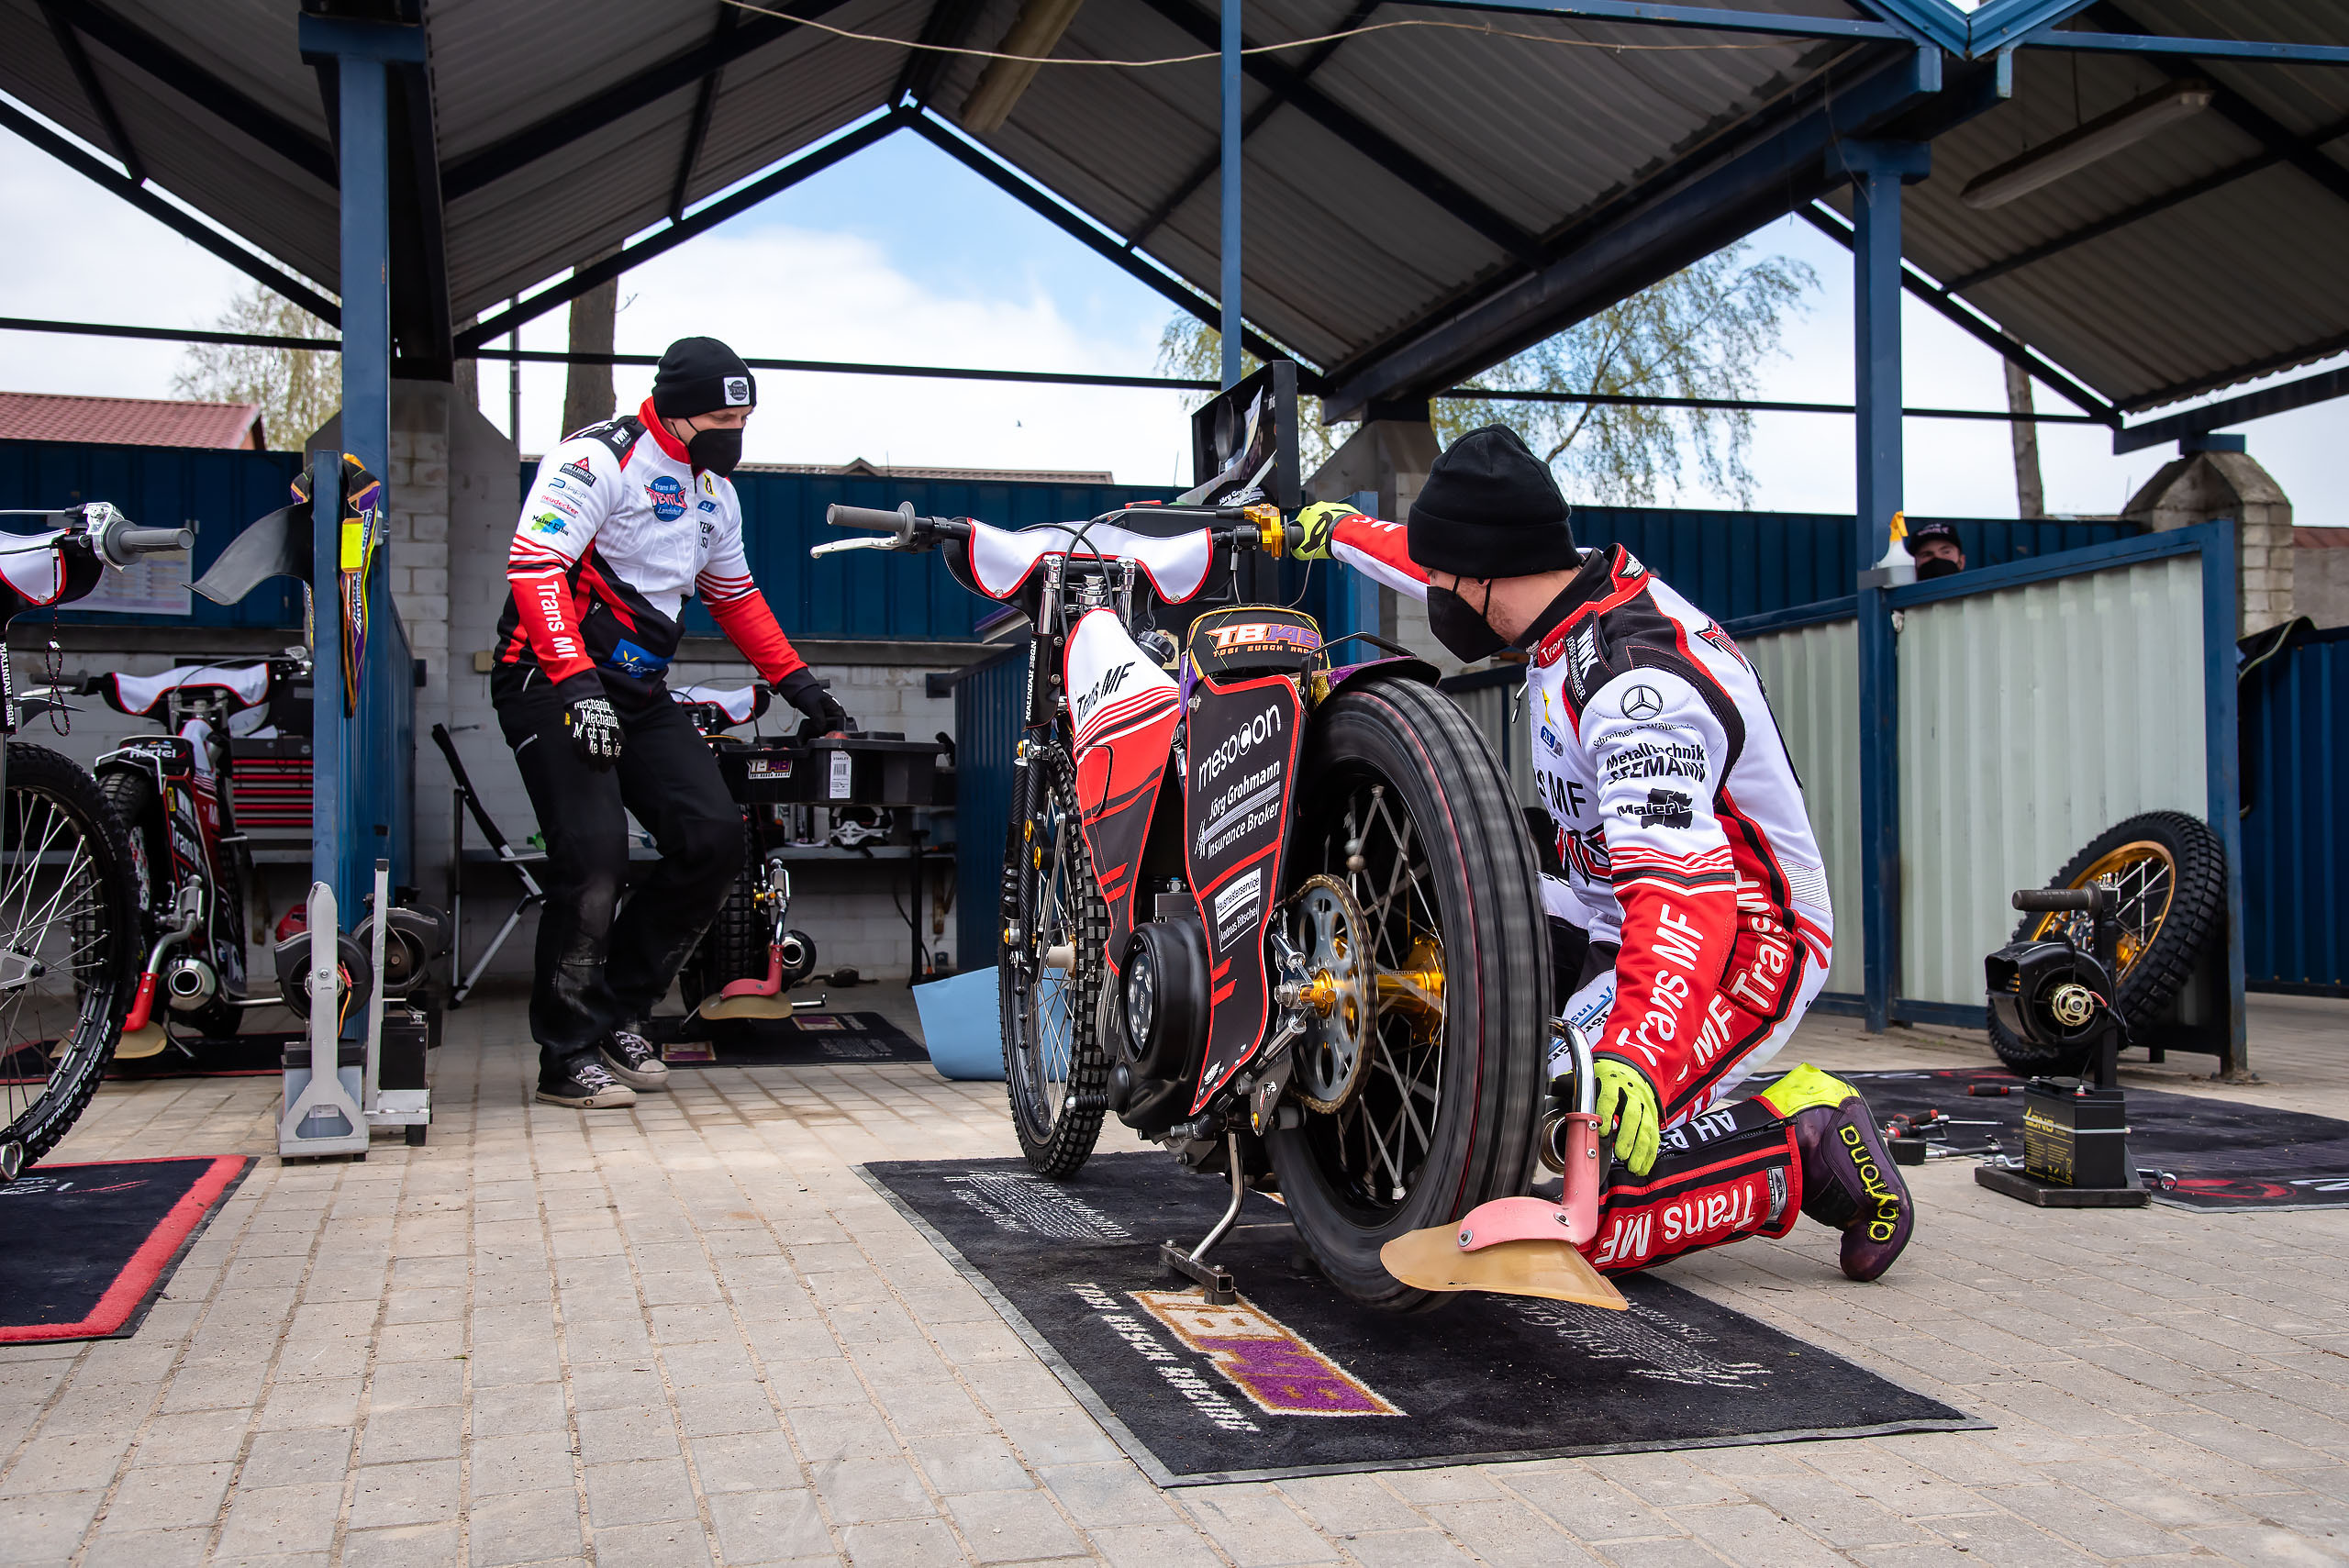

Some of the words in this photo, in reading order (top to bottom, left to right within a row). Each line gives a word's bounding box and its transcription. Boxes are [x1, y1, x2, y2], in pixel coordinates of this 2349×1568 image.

[540, 495, 579, 515] neudecker
[644, 484, 688, 509] DEVILS
[537, 580, 565, 633] Trans
[1213, 646, 1239, 658] TOBI
[1246, 644, 1283, 652] BUSCH
[1290, 646, 1323, 660] RACG
[1100, 661, 1136, 699] MF
[581, 708, 620, 729] Mechanix
[1208, 795, 1227, 822] Jörg
[1227, 760, 1281, 806] Grohmann
[1548, 770, 1587, 819] MF
[1208, 821, 1246, 861] Insurance
[1247, 800, 1281, 833] Broker
[1216, 877, 1260, 915] Hausmeisterservice
[1219, 920, 1238, 943] Andreas
[1652, 903, 1705, 971] MF
[1583, 1010, 1609, 1034] Jör
[1616, 969, 1690, 1067] Trans
[1692, 994, 1732, 1066] MF
[44, 1081, 82, 1129] PLATINUM
[1689, 1109, 1738, 1142] AH
[1664, 1184, 1755, 1240] Trans
[1595, 1213, 1652, 1264] MF
[1101, 1314, 1180, 1362] BUSCH
